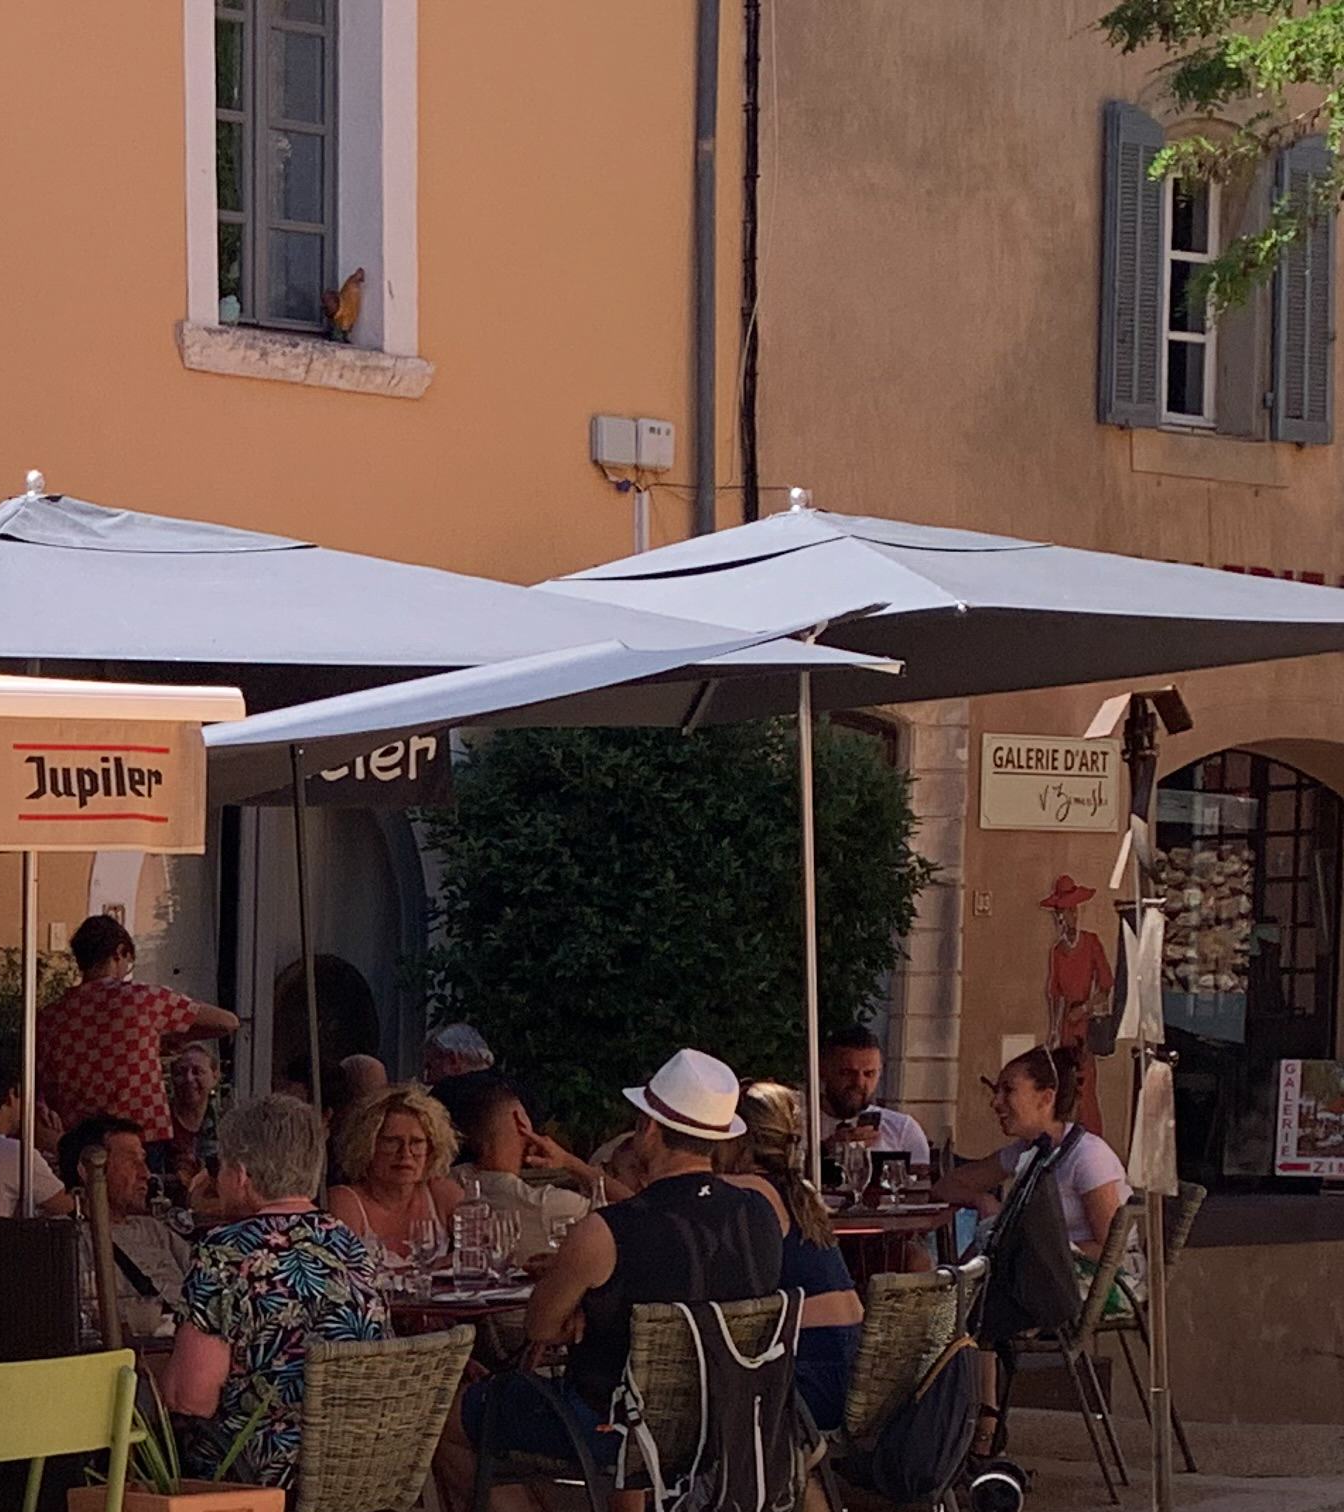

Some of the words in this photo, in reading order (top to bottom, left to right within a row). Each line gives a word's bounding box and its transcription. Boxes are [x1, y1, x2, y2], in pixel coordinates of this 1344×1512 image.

[25, 755, 163, 809] Jupiler
[993, 746, 1058, 771] GALERIE
[1064, 750, 1109, 773] D'ART
[1281, 1063, 1297, 1157] GALERIE
